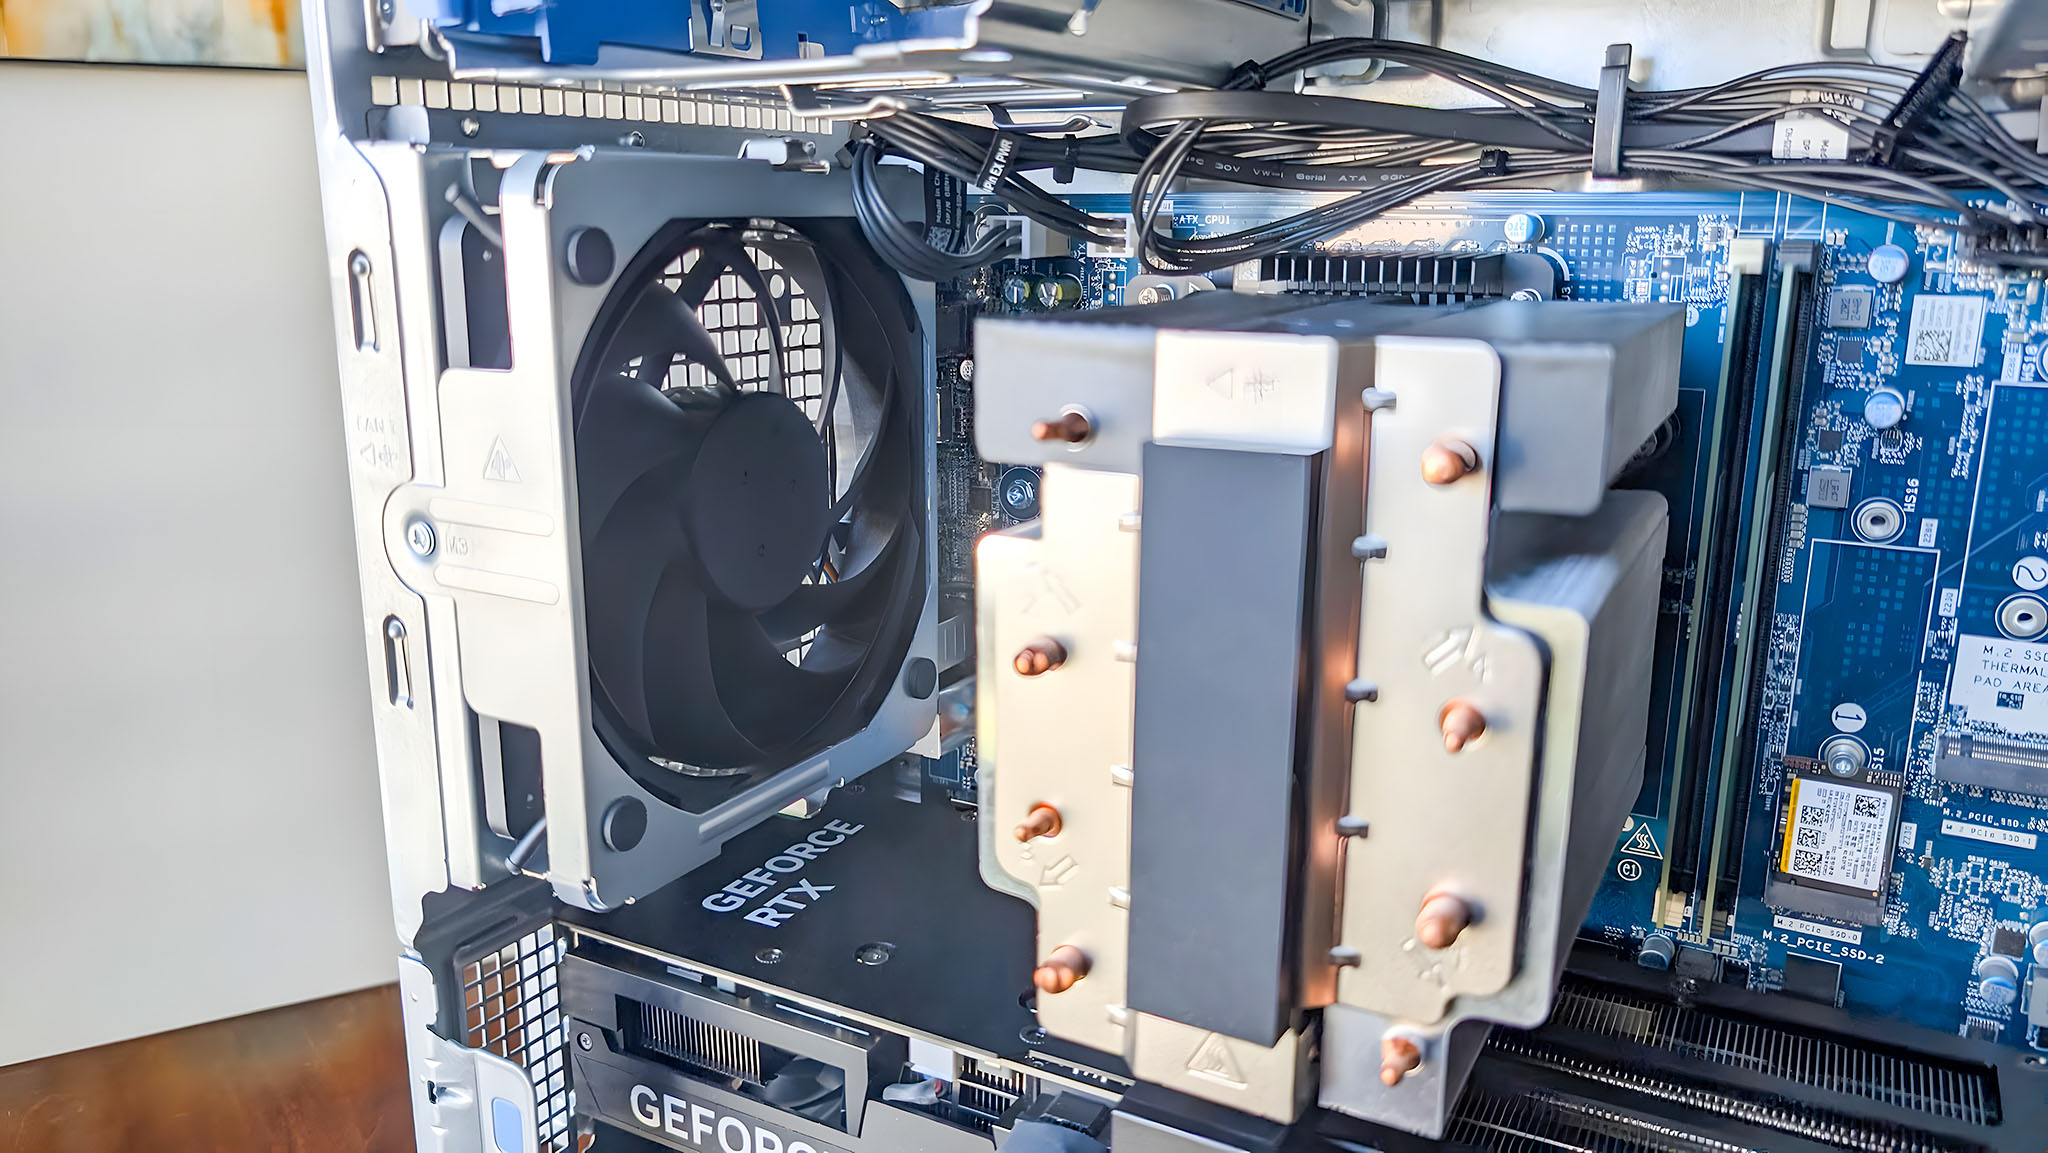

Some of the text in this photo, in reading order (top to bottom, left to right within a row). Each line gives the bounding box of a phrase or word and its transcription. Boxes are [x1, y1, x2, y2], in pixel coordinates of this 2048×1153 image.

[996, 139, 1014, 163] PWR
[989, 163, 1005, 177] EX
[1296, 173, 1327, 182] Serial
[1338, 174, 1368, 182] ATA
[1903, 478, 1919, 513] HS16
[2015, 565, 2047, 582] 2
[1983, 645, 2012, 658] M.2
[1982, 659, 2047, 677] THERMAL
[1974, 675, 2002, 688] PAD
[1836, 711, 1864, 722] 1
[702, 818, 865, 912] GEFORCE
[743, 878, 836, 928] RTX
[1777, 918, 1794, 928] M.2
[1762, 929, 1885, 965] M.2_PCIE_SSD-2
